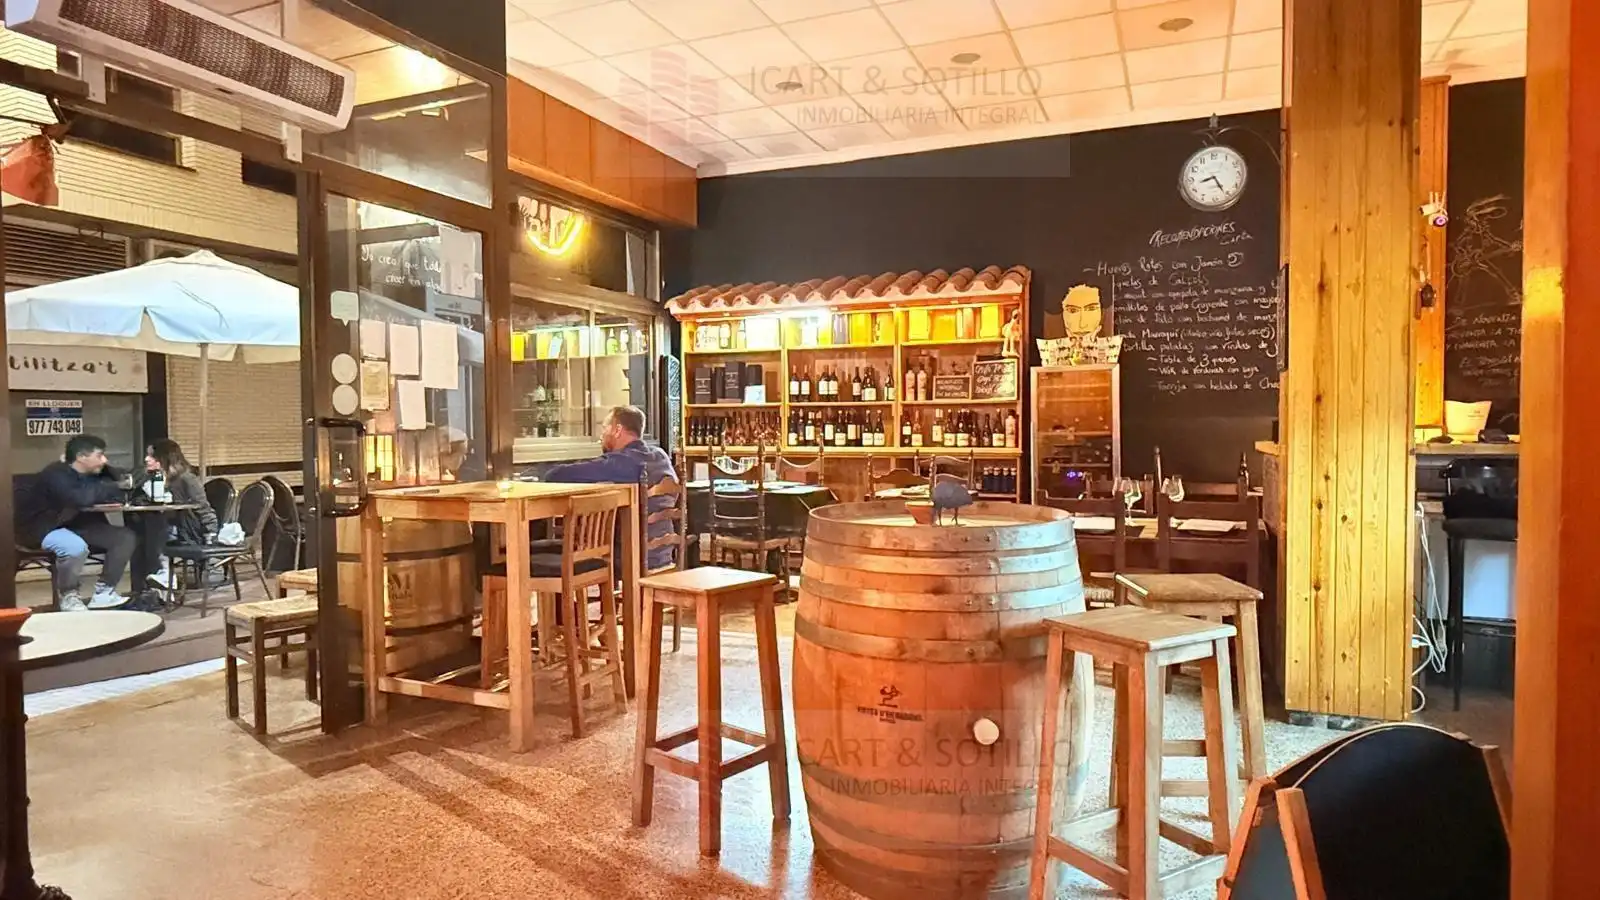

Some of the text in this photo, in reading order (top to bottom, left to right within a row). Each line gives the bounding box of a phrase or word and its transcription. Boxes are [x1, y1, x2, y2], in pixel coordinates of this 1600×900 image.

[1199, 353, 1210, 367] 3
[29, 419, 81, 434] 977 743 048
